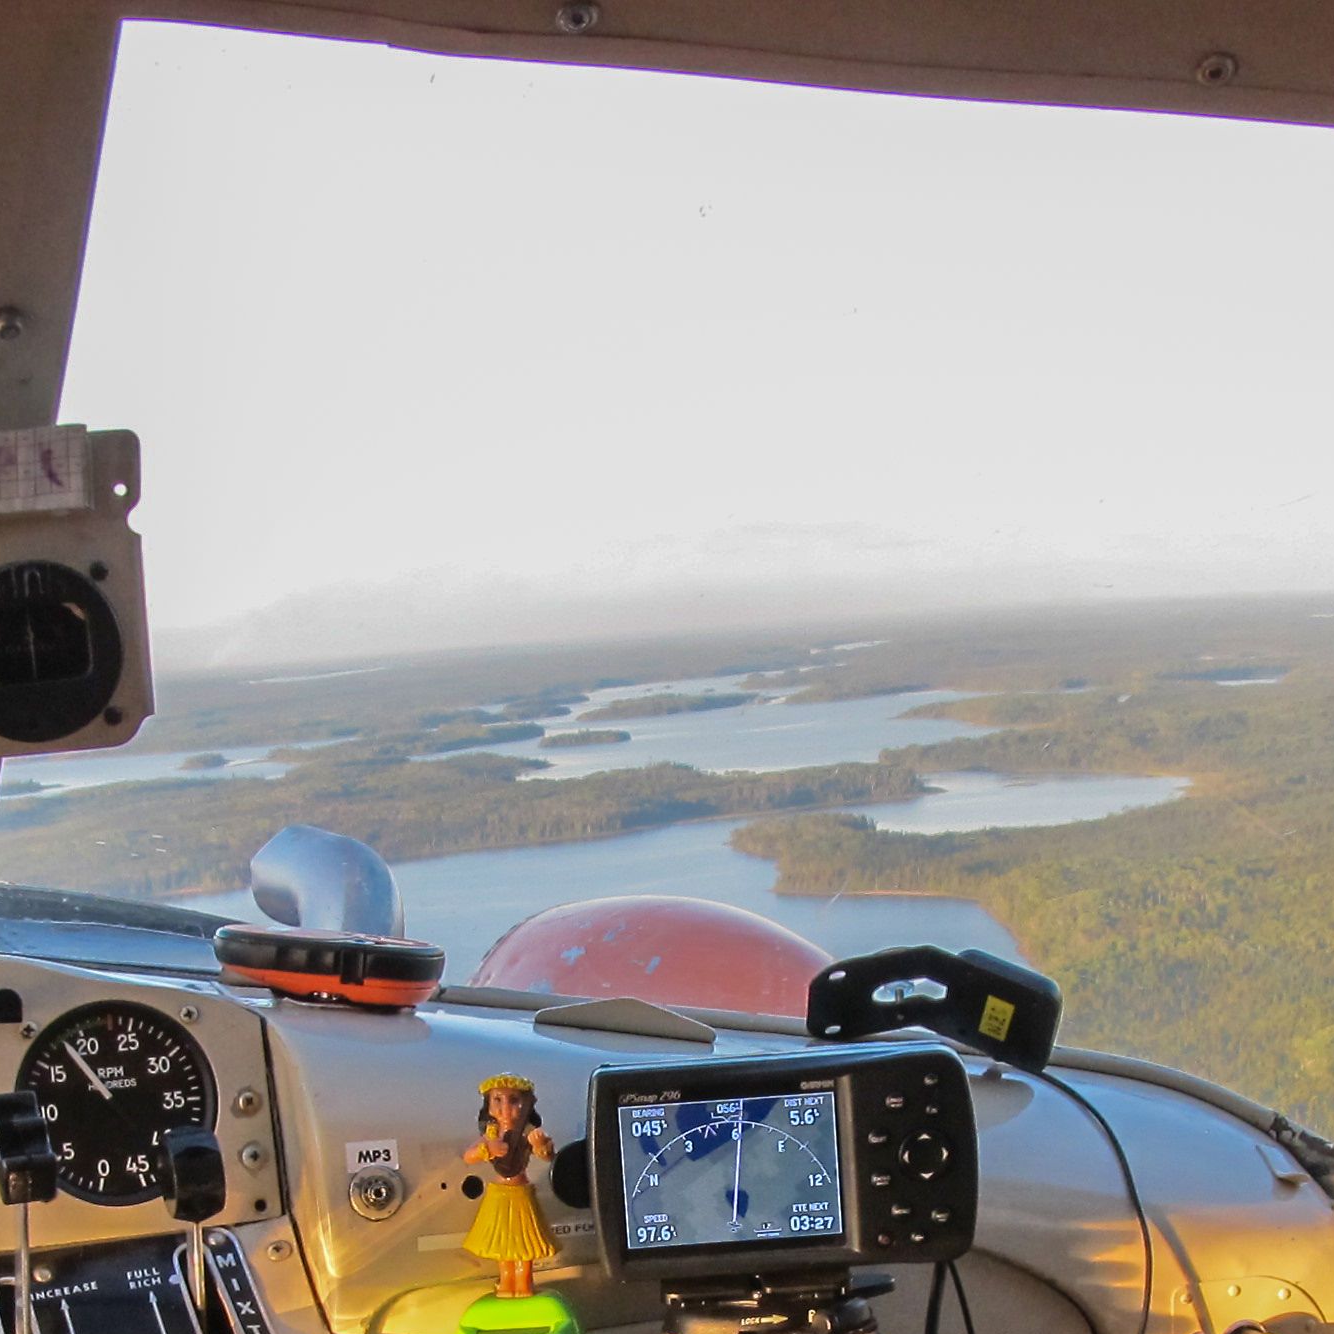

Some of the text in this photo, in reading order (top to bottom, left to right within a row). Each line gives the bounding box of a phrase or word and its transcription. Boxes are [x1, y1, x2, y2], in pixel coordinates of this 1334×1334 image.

[77, 1037, 98, 1054] 20
[117, 1032, 139, 1051] 25
[97, 1066, 124, 1078] RPM
[147, 1056, 170, 1074] 30
[50, 1066, 66, 1083] 15
[162, 1091, 185, 1109] 35
[784, 1096, 824, 1107] DIST NEXT
[632, 1108, 665, 1118] BEARING
[731, 1128, 740, 1140] 6
[685, 1140, 693, 1152] 3
[778, 1140, 786, 1153] E
[357, 1149, 392, 1163] MP3
[98, 1159, 110, 1176] 0
[126, 1155, 149, 1173] 45
[649, 1174, 659, 1187] N
[808, 1174, 823, 1187] 12
[792, 1202, 829, 1212] ETE NEXT
[790, 1216, 834, 1231] 03:27
[126, 1267, 160, 1280] FULL
[129, 1276, 162, 1290] RICH
[30, 1281, 98, 1300] INCREASE
